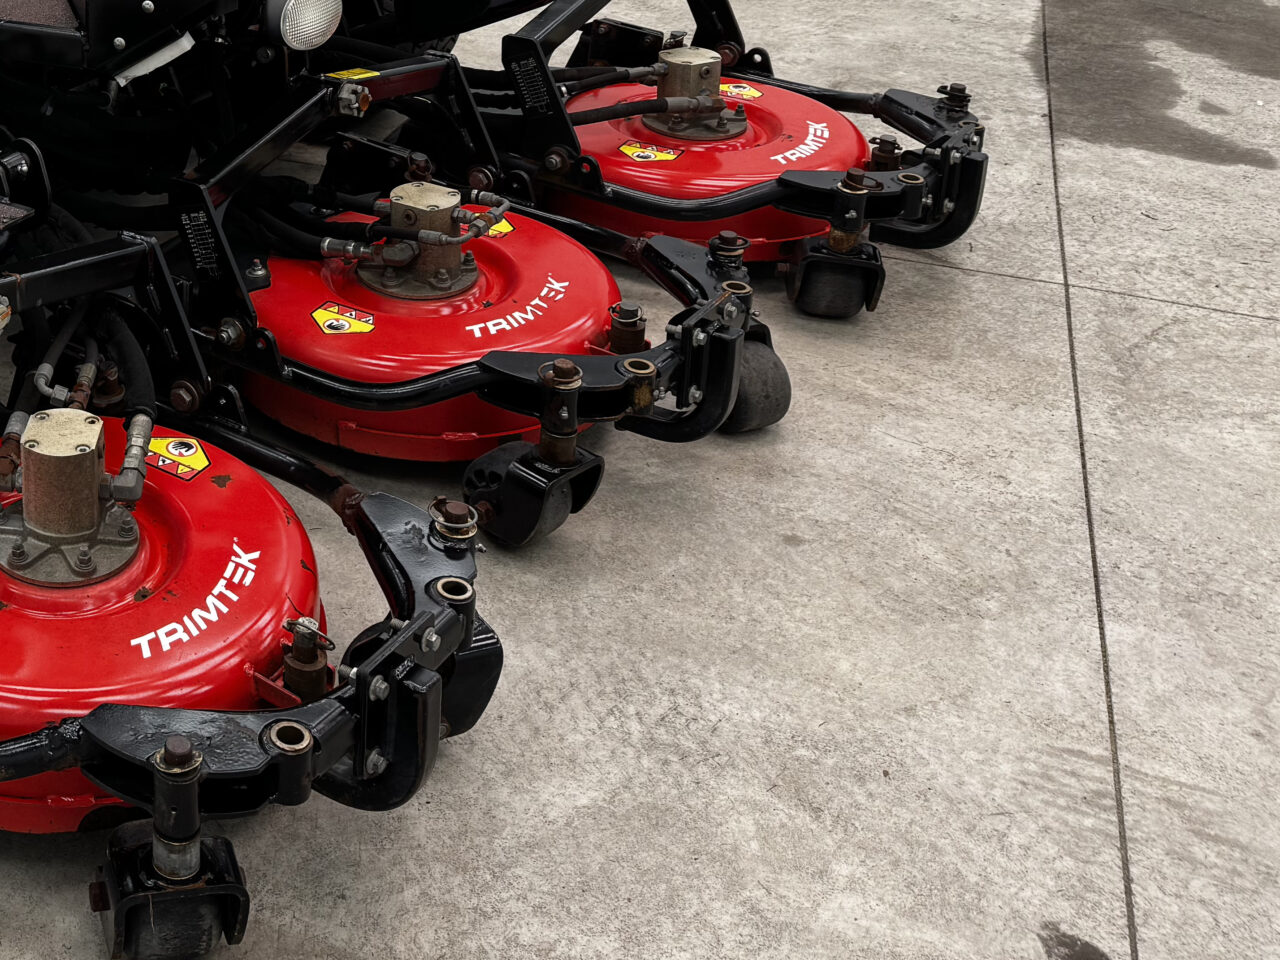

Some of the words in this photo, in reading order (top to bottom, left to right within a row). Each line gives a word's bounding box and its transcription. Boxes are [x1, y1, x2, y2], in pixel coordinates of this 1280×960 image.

[769, 120, 830, 165] TRIMTEK
[465, 276, 570, 338] TRIMTEK
[130, 542, 261, 659] TRIMTEK
